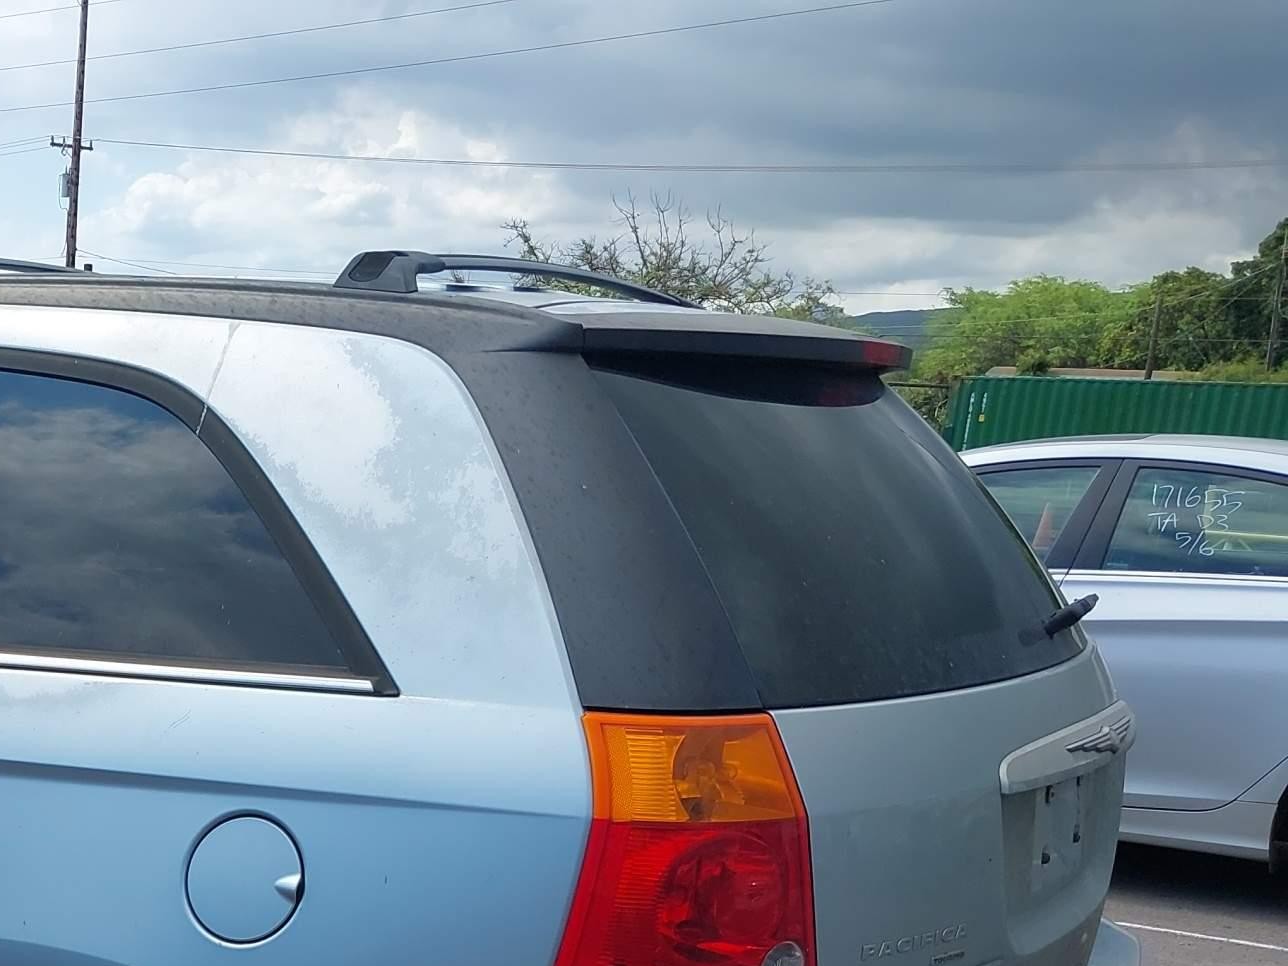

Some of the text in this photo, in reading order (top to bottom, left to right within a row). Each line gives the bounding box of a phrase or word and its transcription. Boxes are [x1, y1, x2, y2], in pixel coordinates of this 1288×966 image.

[1152, 484, 1246, 514] 171655
[1148, 512, 1179, 532] TA
[1175, 530, 1214, 556] 5/6
[859, 923, 967, 961] PACIFICA
